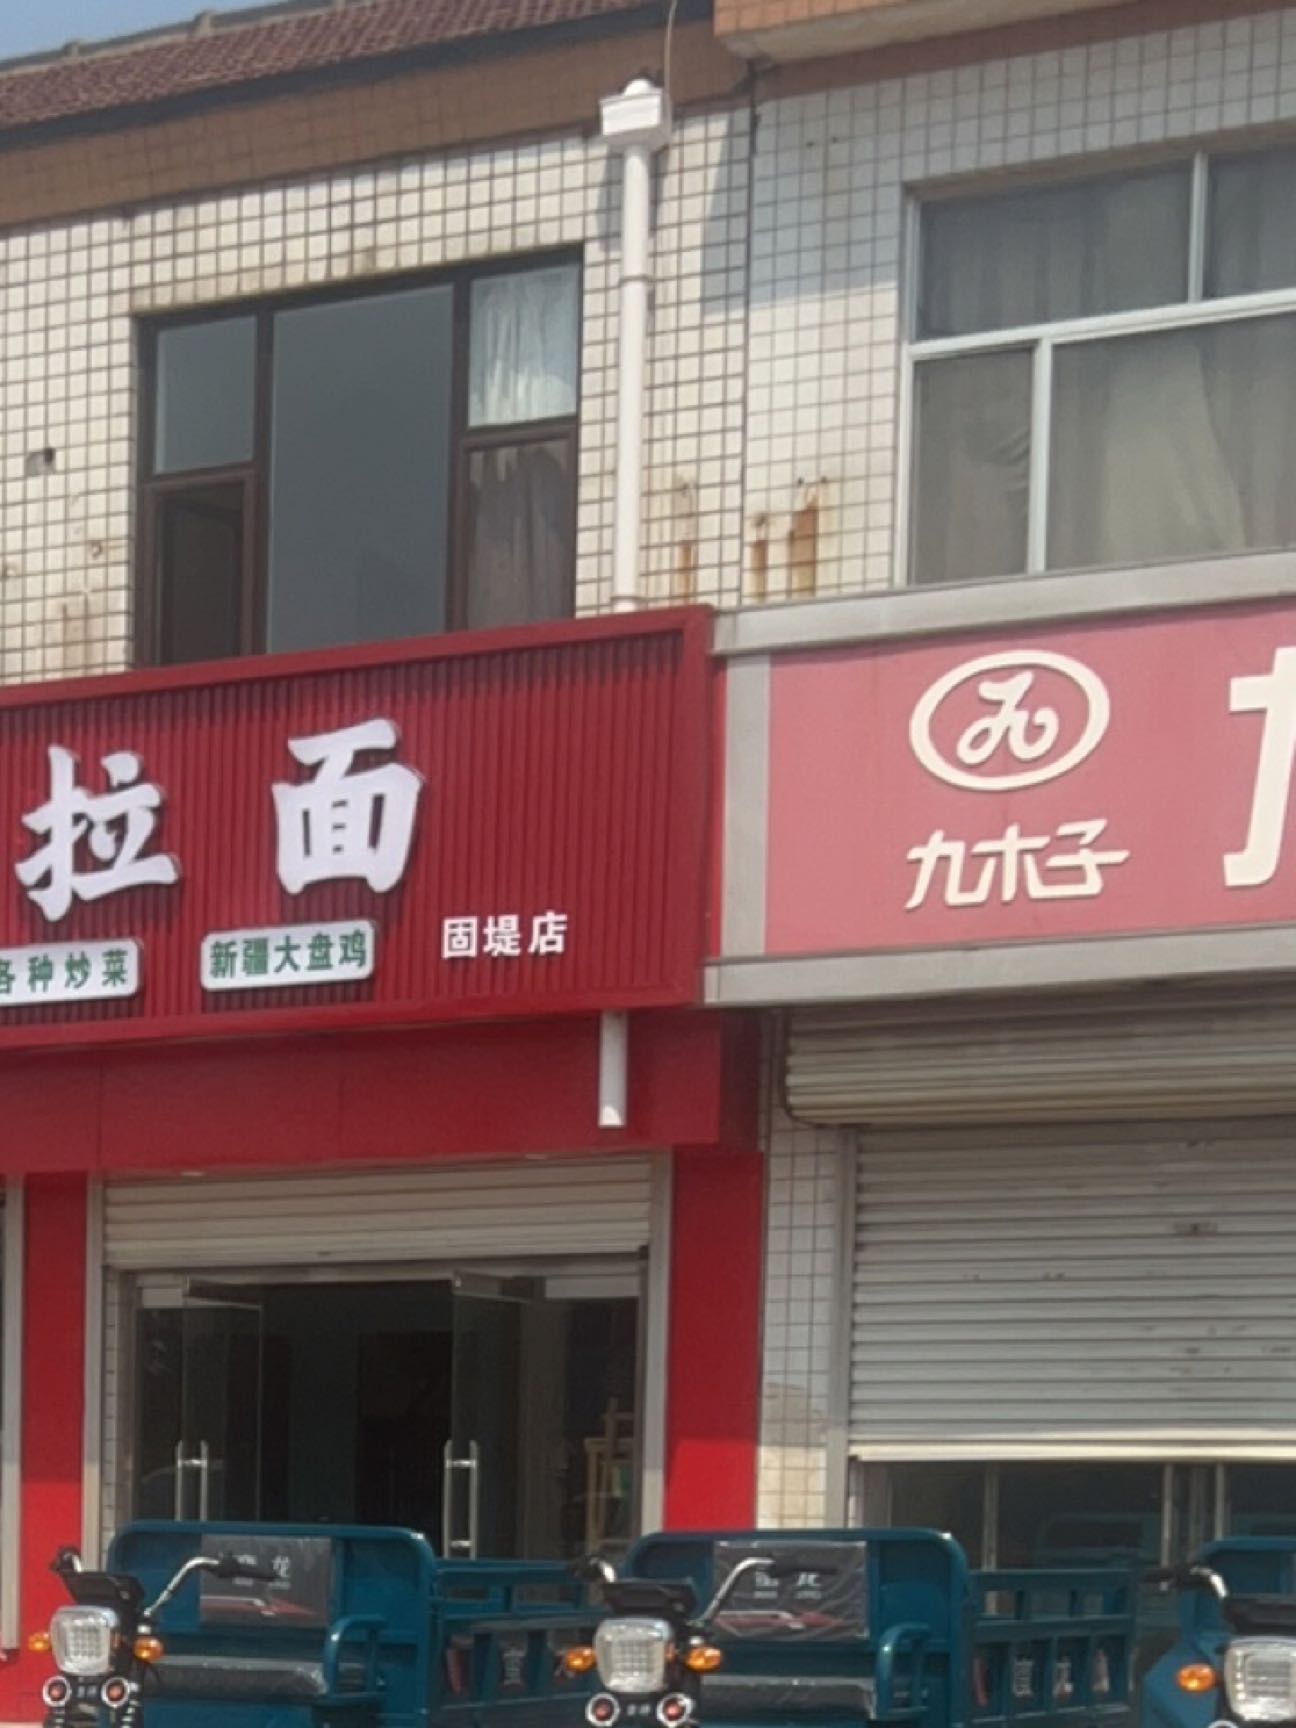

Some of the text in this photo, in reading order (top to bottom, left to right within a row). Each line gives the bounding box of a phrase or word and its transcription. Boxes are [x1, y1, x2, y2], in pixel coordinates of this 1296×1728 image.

[904, 819, 1131, 911] 九木子
[209, 928, 368, 979] 新疆大盘鸡
[442, 911, 569, 959] 固堤店
